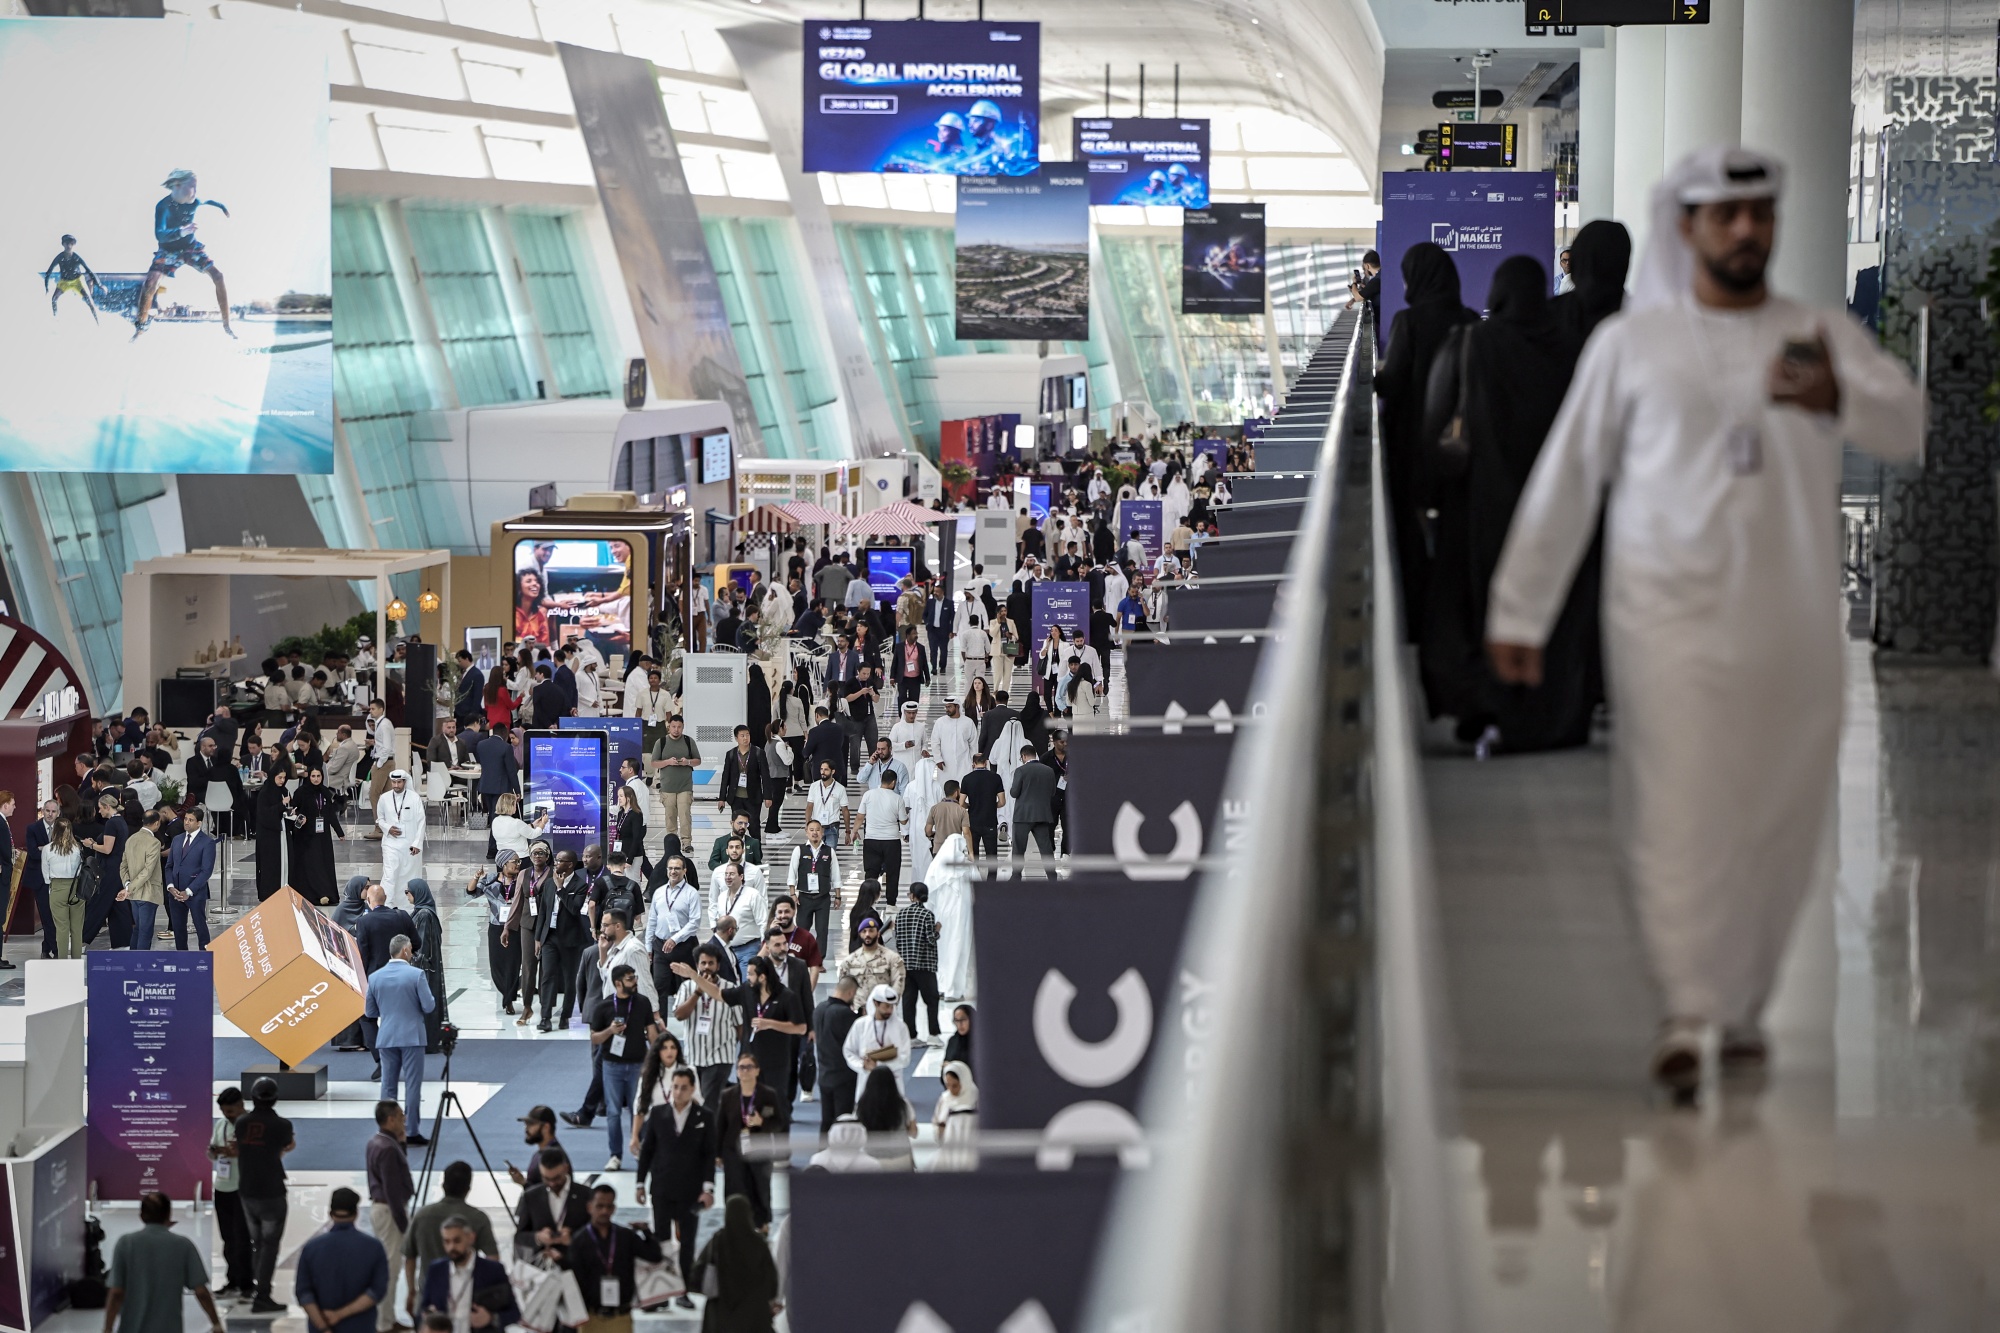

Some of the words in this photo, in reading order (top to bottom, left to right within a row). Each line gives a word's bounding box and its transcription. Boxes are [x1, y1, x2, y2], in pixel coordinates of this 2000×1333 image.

[819, 62, 901, 80] GLOBAL
[903, 64, 1023, 81] INDUSTRIAL
[927, 84, 1023, 97] ACCELERATOR
[1081, 141, 1129, 152] GLOBAL
[1130, 141, 1201, 153] INDUSTRIAL
[1460, 233, 1490, 243] MAKE
[1492, 233, 1503, 243] IT
[250, 911, 262, 930] It's
[235, 924, 246, 941] an
[253, 927, 268, 956] never
[238, 939, 256, 979] address
[257, 953, 273, 977] just
[149, 1008, 159, 1016] 13
[260, 981, 329, 1034] ETIHAD
[288, 1002, 319, 1027] CARGO
[146, 1092, 160, 1100] 1-4
